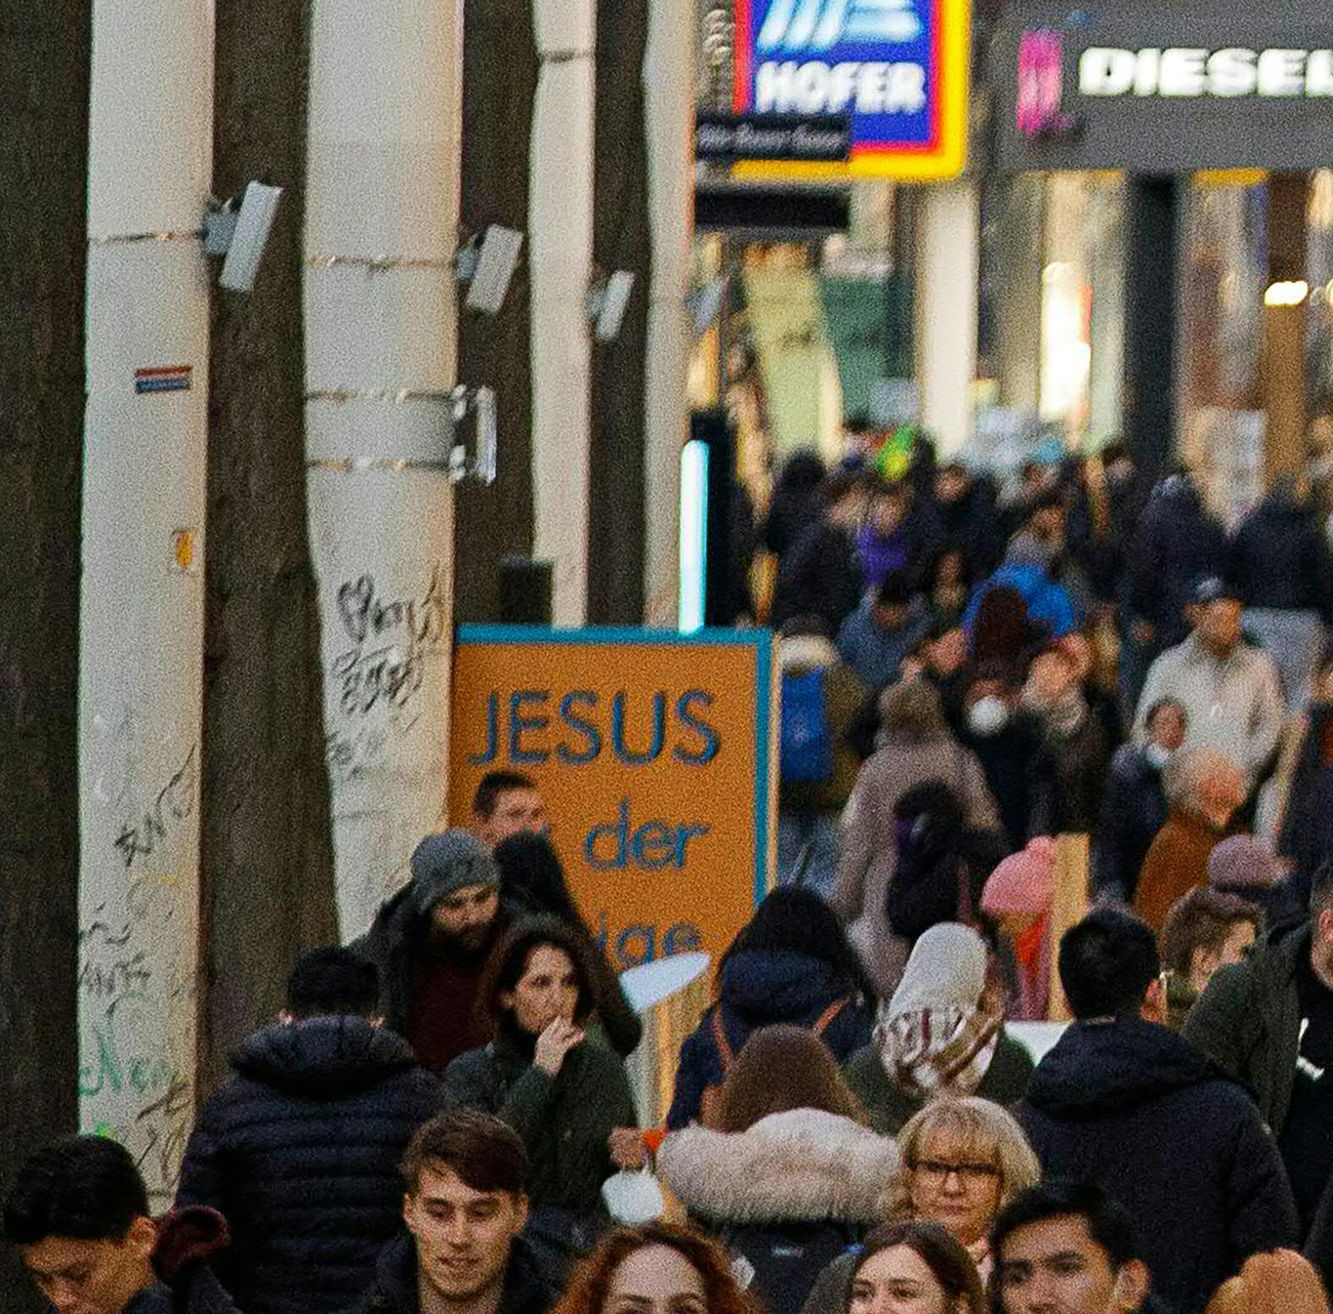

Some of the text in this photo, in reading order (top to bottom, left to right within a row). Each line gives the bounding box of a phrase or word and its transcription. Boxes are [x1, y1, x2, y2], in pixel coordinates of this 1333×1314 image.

[755, 60, 927, 114] HOFER
[467, 689, 721, 765] JESUS
[583, 796, 711, 870] der
